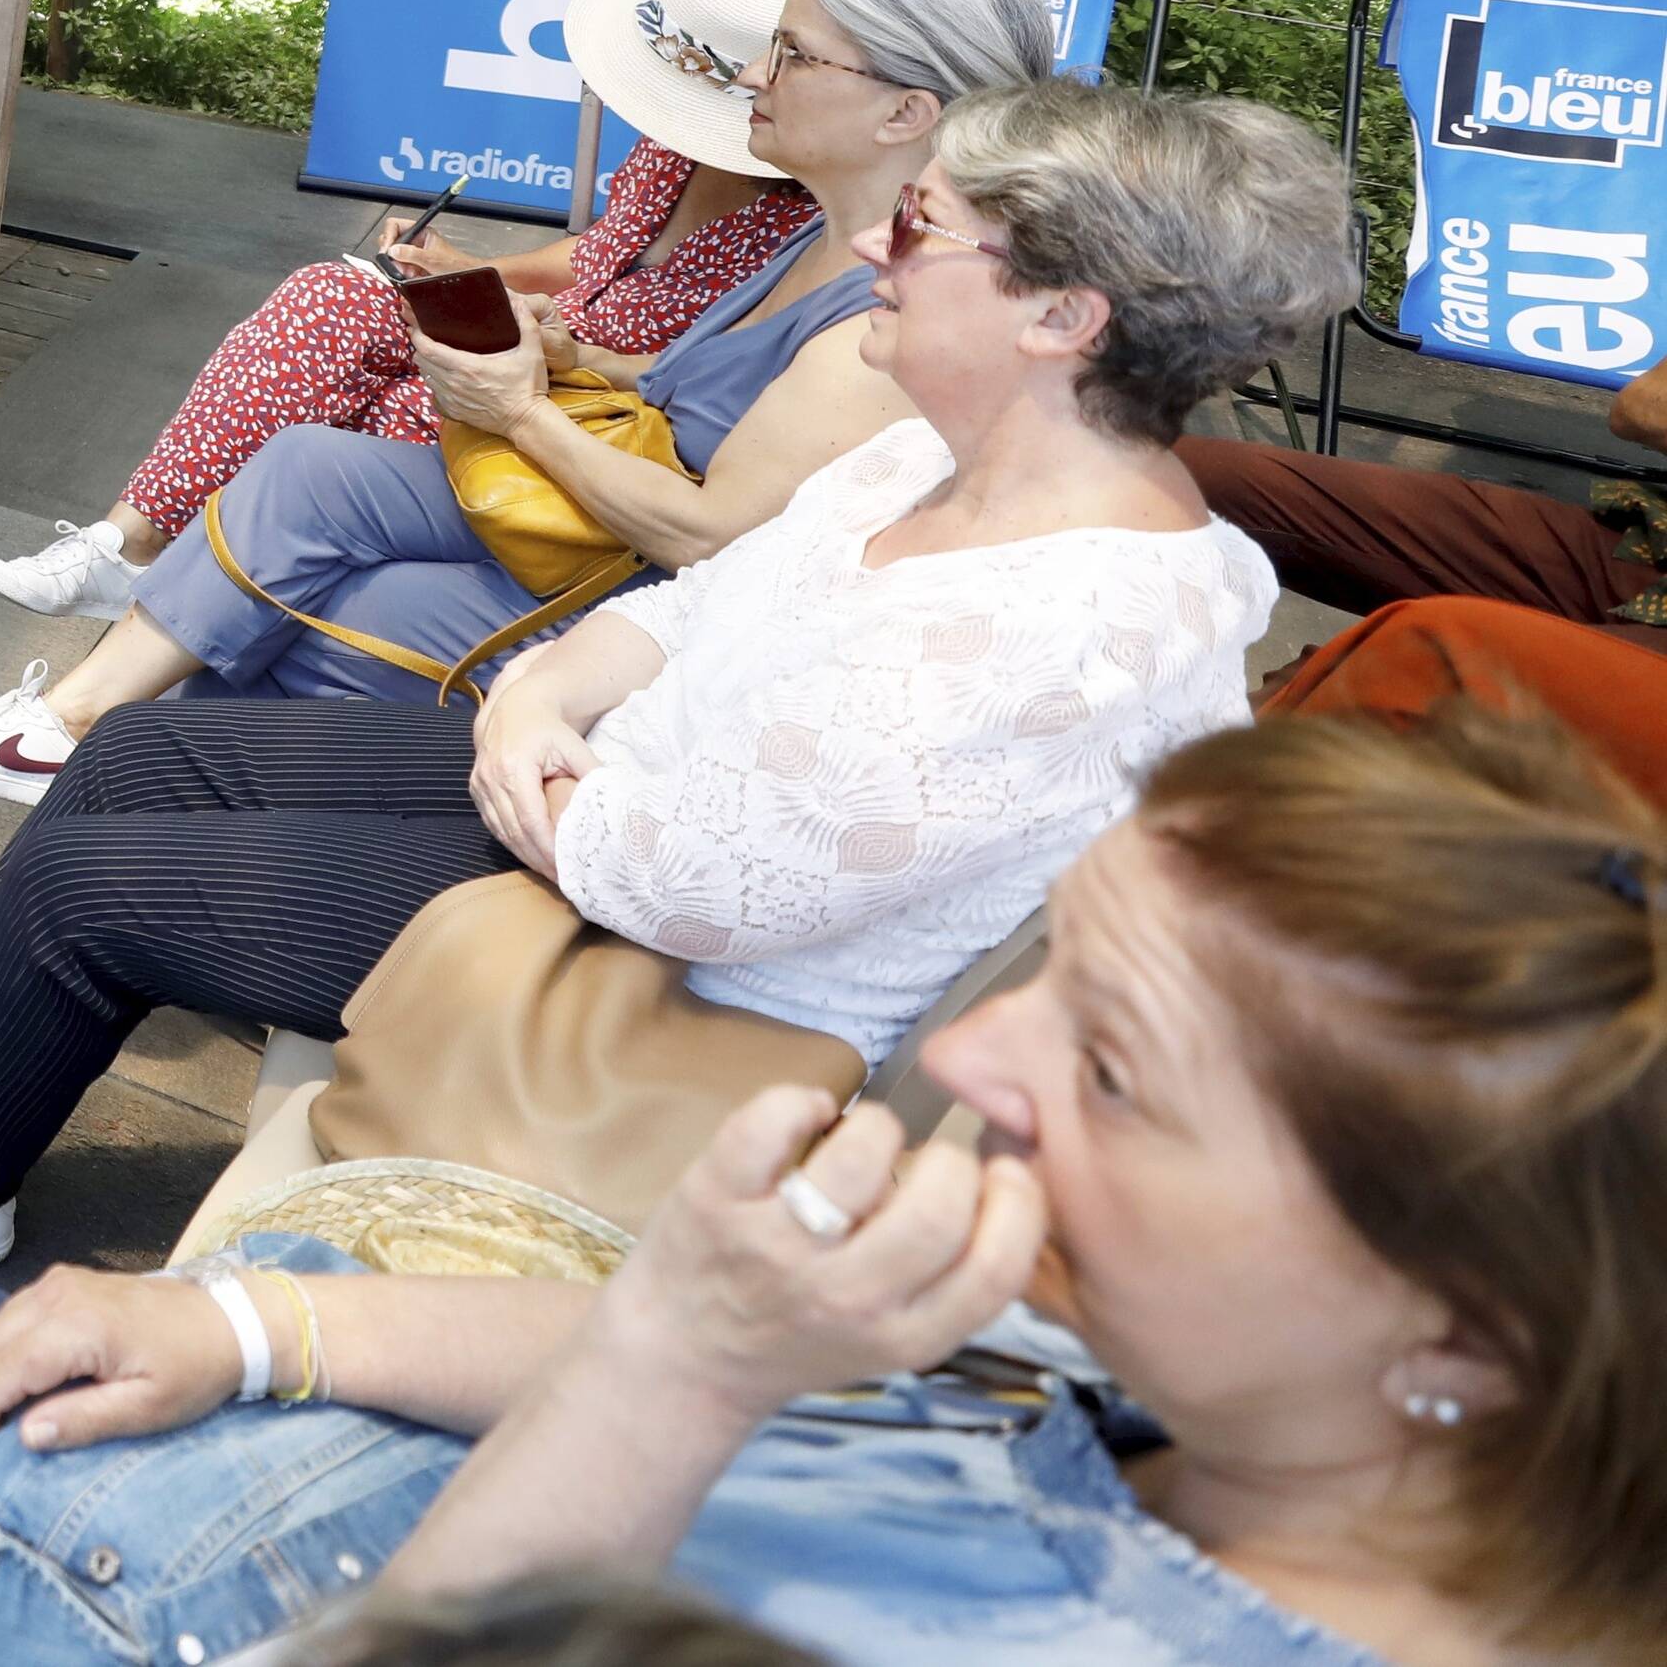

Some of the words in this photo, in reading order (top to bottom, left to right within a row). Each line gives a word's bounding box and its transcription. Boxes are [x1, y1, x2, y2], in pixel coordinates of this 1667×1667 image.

[1480, 71, 1651, 136] bleu
[1554, 67, 1653, 95] france
[1431, 217, 1490, 350] france
[1507, 224, 1654, 370] eu
